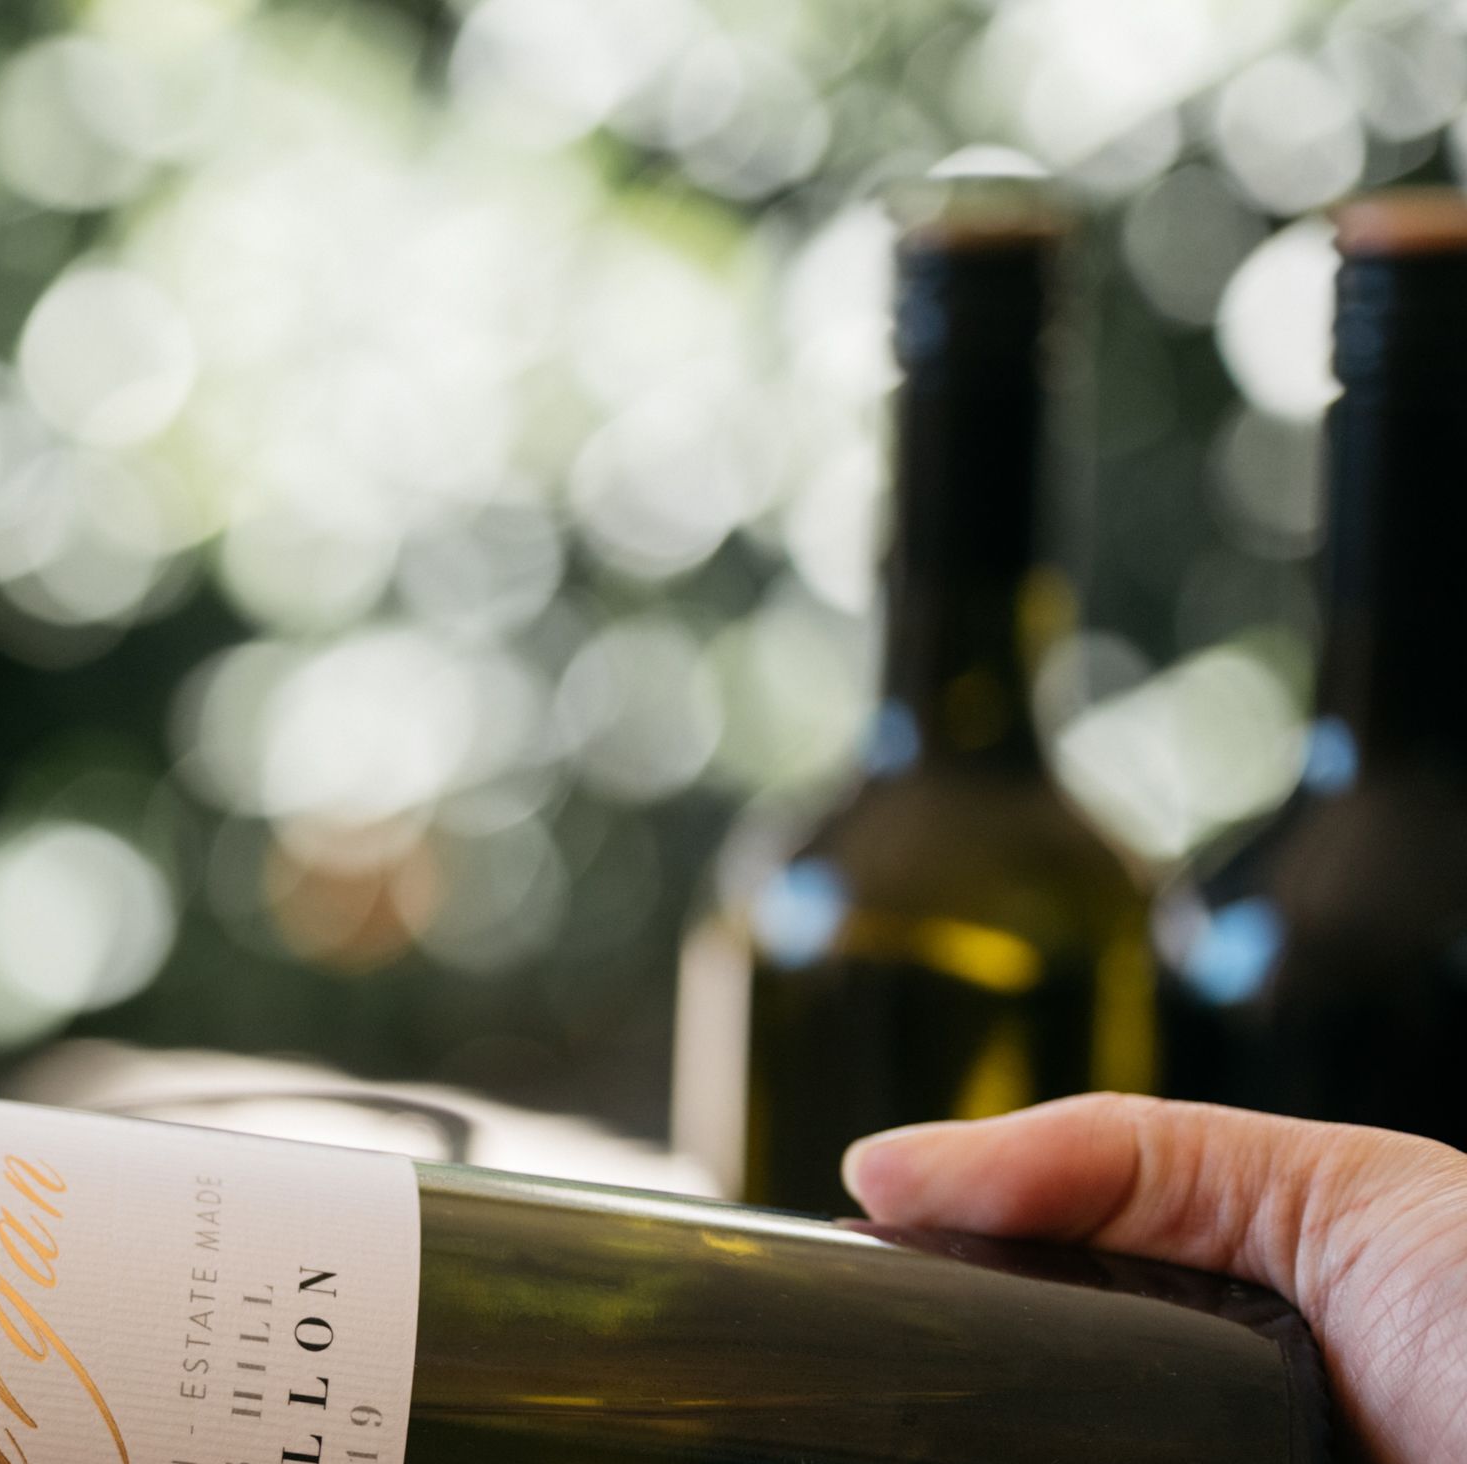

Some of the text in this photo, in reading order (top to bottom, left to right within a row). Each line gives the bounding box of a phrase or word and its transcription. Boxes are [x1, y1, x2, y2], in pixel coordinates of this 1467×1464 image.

[194, 1174, 223, 1252] MADE
[179, 1266, 219, 1400] ESTATE
[230, 1284, 275, 1419] HILL
